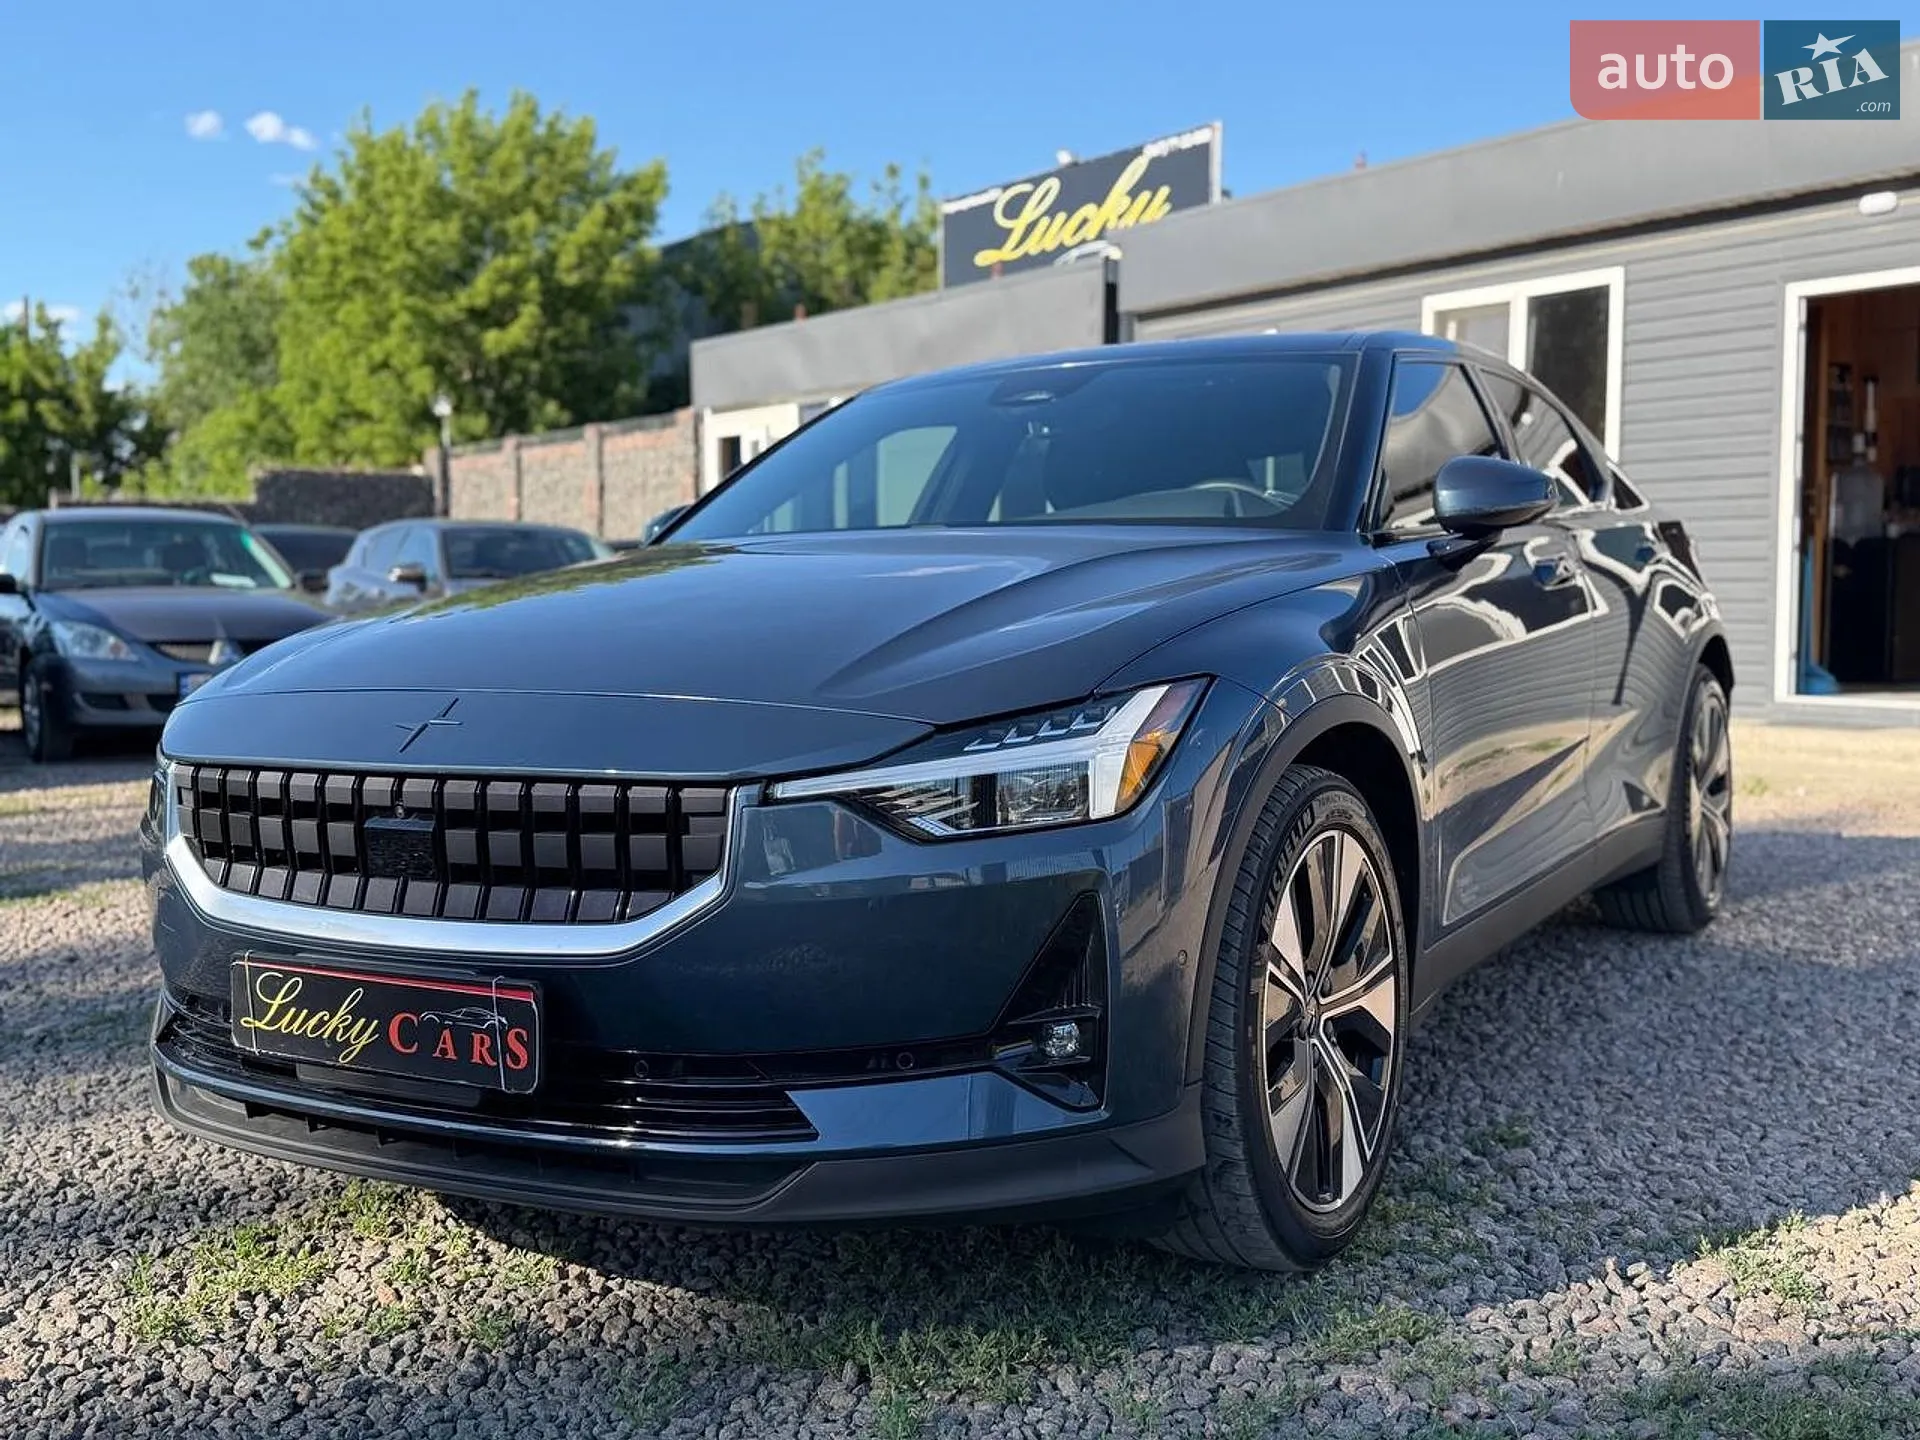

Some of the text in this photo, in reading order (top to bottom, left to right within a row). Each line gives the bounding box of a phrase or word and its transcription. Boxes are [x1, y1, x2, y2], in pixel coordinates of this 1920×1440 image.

[1262, 804, 1313, 935] MICHELIN
[240, 971, 529, 1070] Lucky CARS
